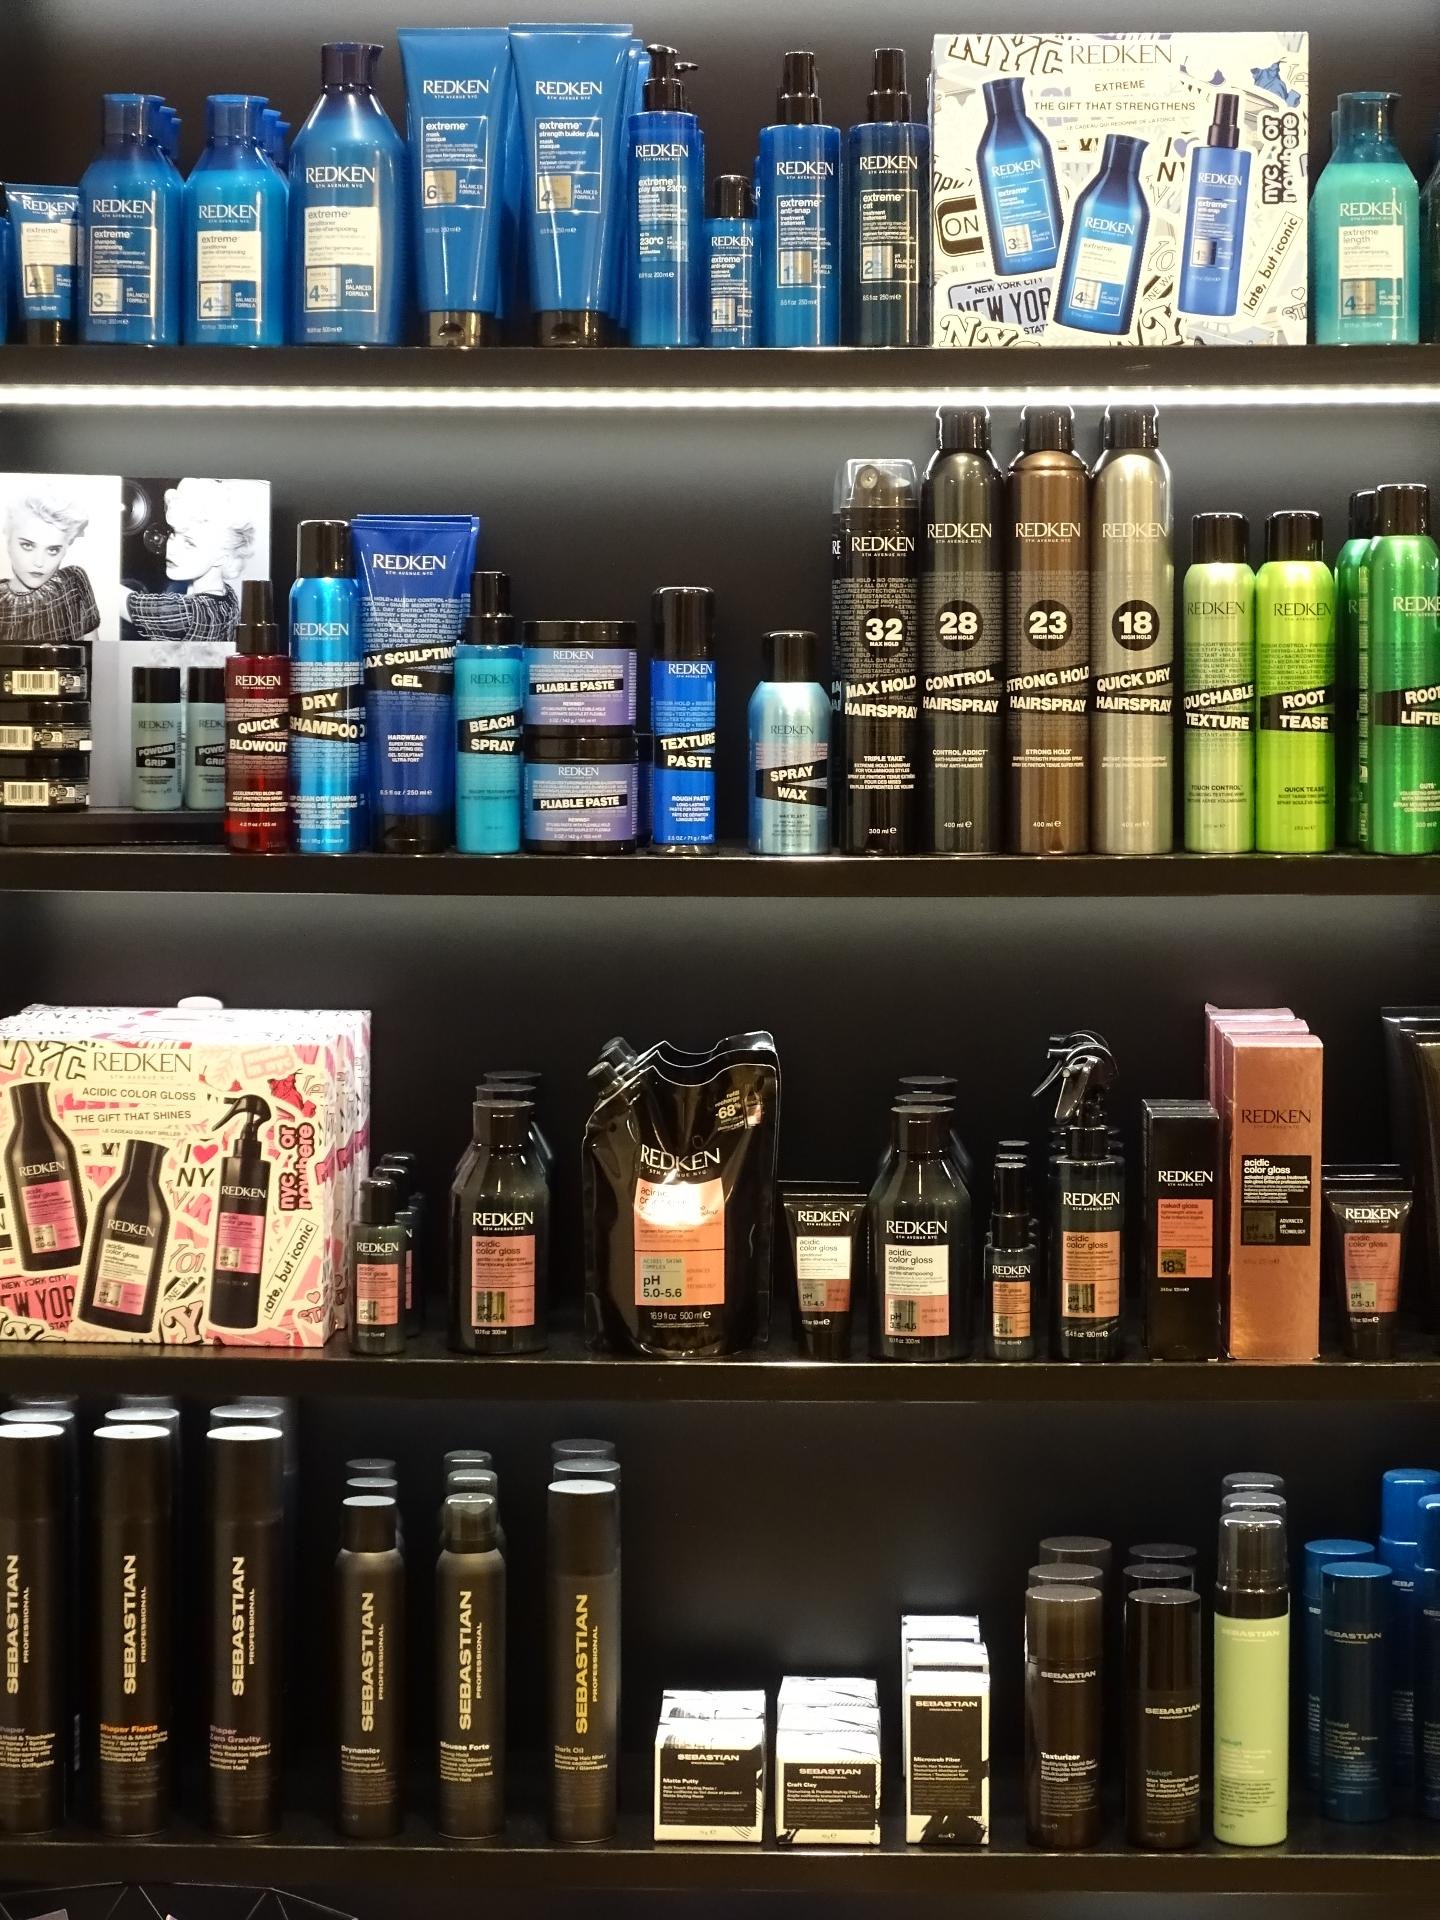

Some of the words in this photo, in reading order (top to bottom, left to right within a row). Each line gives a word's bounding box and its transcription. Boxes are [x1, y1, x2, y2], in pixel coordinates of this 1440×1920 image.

[1071, 45, 1172, 64] REDKEN
[423, 80, 489, 95] REDKEN
[536, 80, 602, 96] REDKEN
[1095, 81, 1145, 91] EXTREME
[1034, 102, 1054, 111] THE
[1058, 102, 1081, 111] GIFT
[1086, 102, 1111, 111] THAT
[1116, 102, 1196, 111] STRENGTHENS
[636, 144, 689, 158] REDKEN
[1278, 112, 1299, 203] nowhere
[777, 162, 834, 176] REDKEN
[860, 156, 918, 170] REDKEN
[992, 160, 1041, 177] REDKEN
[306, 167, 376, 183] REDKEN
[1199, 173, 1243, 186] REDKEN
[22, 199, 75, 212] REDKEN
[92, 199, 154, 215] REDKEN
[199, 205, 259, 219] REDKEN
[1340, 202, 1402, 216] REDKEN
[945, 215, 979, 237] ON
[1085, 217, 1135, 235] REDKEN
[94, 229, 130, 239] extreme
[712, 236, 754, 247] REDKEN
[1243, 283, 1267, 312] late,
[1258, 256, 1278, 279] but
[1275, 217, 1298, 256] iconic
[974, 285, 995, 295] NEW
[999, 281, 1021, 290] YORK
[927, 523, 992, 539] REDKEN
[1015, 522, 1081, 538] REDKEN
[1102, 522, 1167, 538] REDKEN
[852, 537, 915, 552] REDKEN
[373, 553, 446, 571] REDKEN
[1187, 601, 1246, 616] REDKEN
[1274, 602, 1332, 617] REDKEN
[293, 622, 349, 636] REDKEN
[865, 618, 903, 641] 32
[940, 612, 978, 635] 28
[1029, 611, 1067, 634] 23
[1118, 611, 1152, 635] 18
[553, 650, 594, 660] REDKEN
[668, 663, 713, 675] REDKEN
[235, 675, 281, 686] REDKEN
[391, 674, 423, 688] GEL
[536, 681, 579, 693] PLIABLE
[580, 679, 615, 692] PASTE
[846, 681, 880, 699] MAX
[881, 676, 917, 693] HOLD
[925, 669, 995, 691] CONTROL
[1006, 672, 1058, 693] STRONG
[1097, 672, 1145, 693] QUICK
[1146, 667, 1171, 685] DRY
[301, 692, 339, 711] DRY
[922, 696, 999, 713] HAIRSPRAY
[1010, 696, 1087, 713] HAIRSPRAY
[1096, 696, 1172, 713] HAIRSPRAY
[1282, 690, 1326, 710] ROOT
[844, 702, 918, 719] HAIRSPRAY
[237, 717, 280, 734] QUICK
[290, 716, 365, 739] SHAMPOO
[469, 715, 515, 733] BEACH
[1186, 712, 1250, 730] TEXTURE
[1279, 714, 1329, 730] TEASE
[770, 725, 814, 736] REDKEN
[229, 738, 287, 753] BLOWOUT
[470, 738, 516, 752] SPRAY
[661, 733, 716, 751] TEXTURE
[138, 744, 174, 757] POWDER
[667, 755, 712, 769] PASTE
[558, 767, 600, 776] REDKEN
[770, 765, 814, 782] SPRAY
[777, 786, 808, 801] WAX
[541, 799, 585, 809] PLIABLE
[586, 796, 620, 807] PASTE
[93, 1052, 191, 1072] REDKEN
[82, 1087, 117, 1098] ACIDIC
[120, 1089, 157, 1099] COLOR
[160, 1091, 196, 1101] GLOSS
[75, 1115, 95, 1123] THE
[97, 1113, 120, 1123] GIFT
[124, 1112, 149, 1121] THAT
[153, 1110, 192, 1120] SHINES
[1242, 1109, 1312, 1124] REDKEN
[640, 1143, 720, 1171] REDKEN
[1244, 1158, 1270, 1167] acidic
[19, 1161, 65, 1177] REDKEN
[294, 1122, 316, 1210] nowhere
[1244, 1166, 1267, 1174] color
[1267, 1166, 1291, 1176] gloss
[1158, 1170, 1213, 1182] REDKEN
[222, 1185, 267, 1199] REDKEN
[1063, 1192, 1120, 1207] REDKEN
[472, 1212, 534, 1226] REDKEN
[797, 1210, 850, 1223] REDKEN
[1345, 1207, 1399, 1220] REDKEN
[108, 1219, 156, 1237] REDKEN
[886, 1220, 948, 1235] REDKEN
[357, 1242, 399, 1253] REDKEN
[264, 1287, 283, 1313] late,
[275, 1260, 296, 1283] but
[292, 1223, 314, 1261] iconic
[992, 1265, 1031, 1275] REDKEN
[2, 1281, 21, 1290] NEW
[24, 1278, 46, 1287] YORK
[643, 1275, 661, 1288] pH
[643, 1288, 682, 1298] 5.0-5.6
[650, 1312, 663, 1320] 16.9
[680, 1312, 694, 1320] 500
[694, 1311, 703, 1319] ml
[6, 1554, 19, 1694] SEBASTIAN
[124, 1555, 137, 1695] SEBASTIAN
[231, 1556, 245, 1696] SEBASTIAN
[1324, 1629, 1382, 1640] SEBASTIAN
[361, 1592, 374, 1732] SEBASTIAN
[459, 1590, 472, 1731] SEBASTIAN
[575, 1593, 588, 1734] SEBASTIAN
[1041, 1670, 1097, 1680] SEBASTIAN
[915, 1700, 978, 1708] SEBASTIAN
[1145, 1703, 1200, 1715] SEBASTIAN
[678, 1754, 740, 1762] SEBASTIAN
[1041, 1751, 1081, 1761] Texturizer
[799, 1768, 862, 1776] SEBASTIAN
[681, 1778, 699, 1786] Putty
